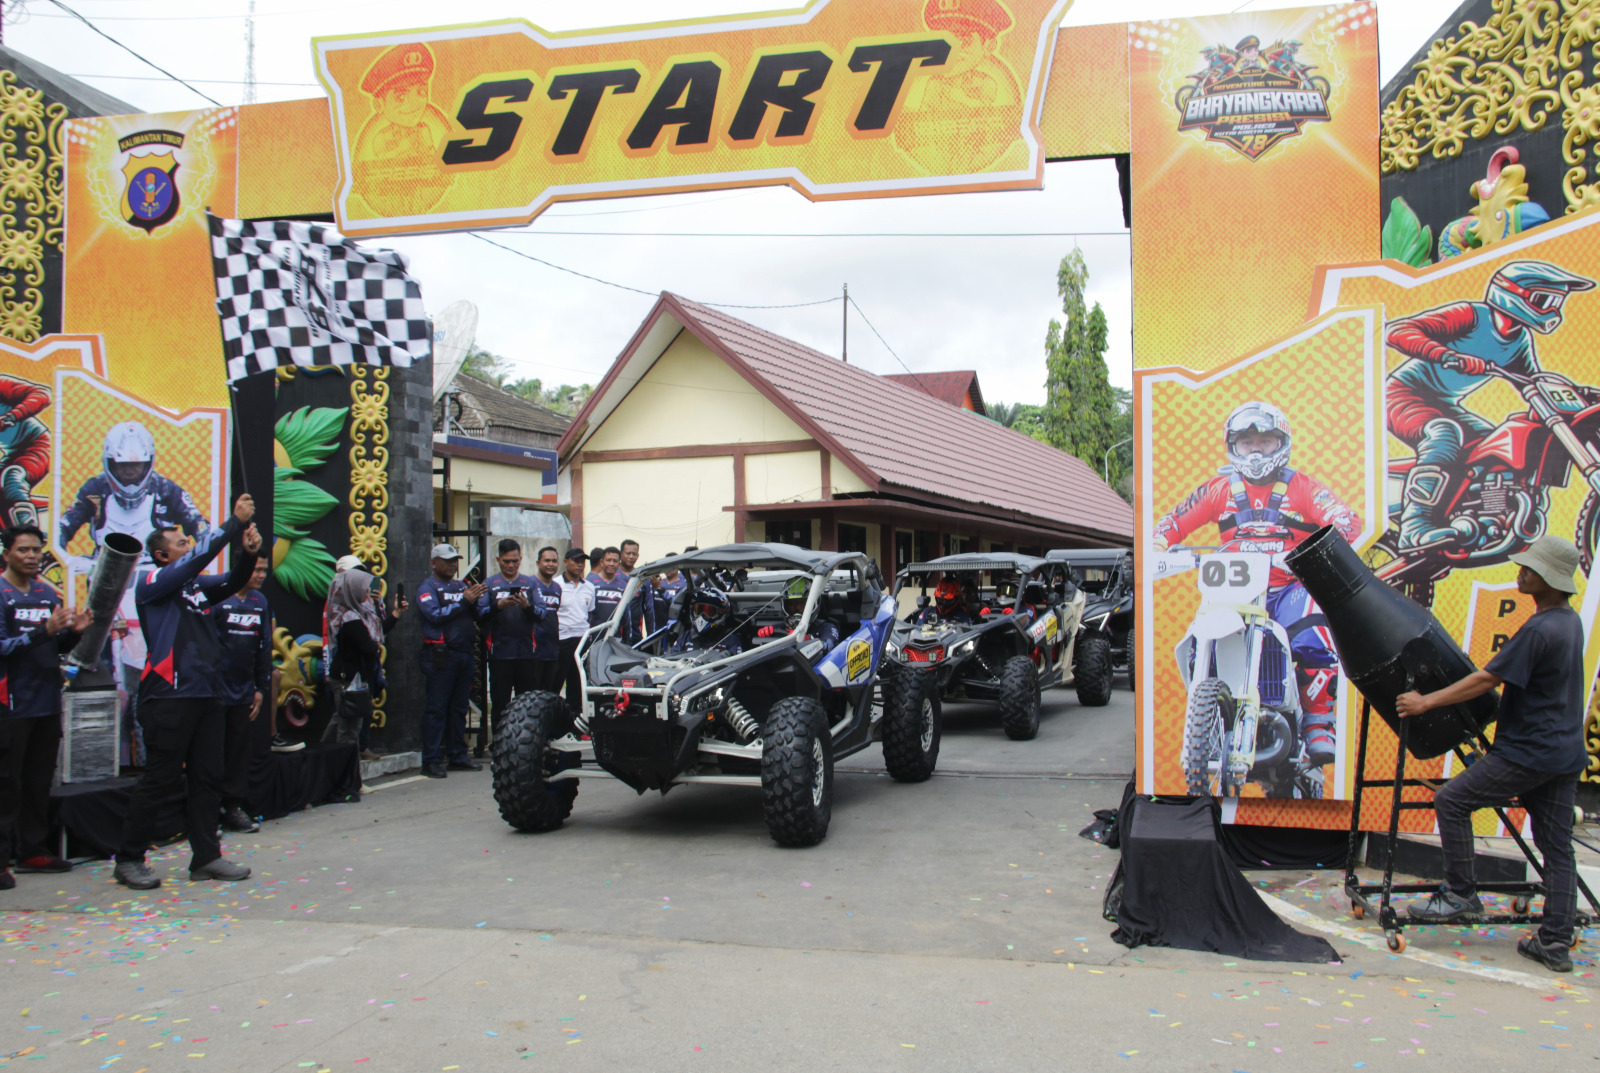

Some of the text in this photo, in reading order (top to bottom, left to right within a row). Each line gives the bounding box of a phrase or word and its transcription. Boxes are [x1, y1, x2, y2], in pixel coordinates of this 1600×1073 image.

[441, 38, 952, 167] START
[1185, 91, 1325, 121] BHAYANGKARA
[1216, 111, 1292, 125] PRESISI
[119, 132, 183, 151] KALIMANTAN TIMUR
[1241, 134, 1268, 151] 78
[1202, 560, 1251, 588] 03
[14, 608, 53, 623] BTA
[227, 613, 262, 627] BTA
[849, 649, 869, 669] OFFROAD
